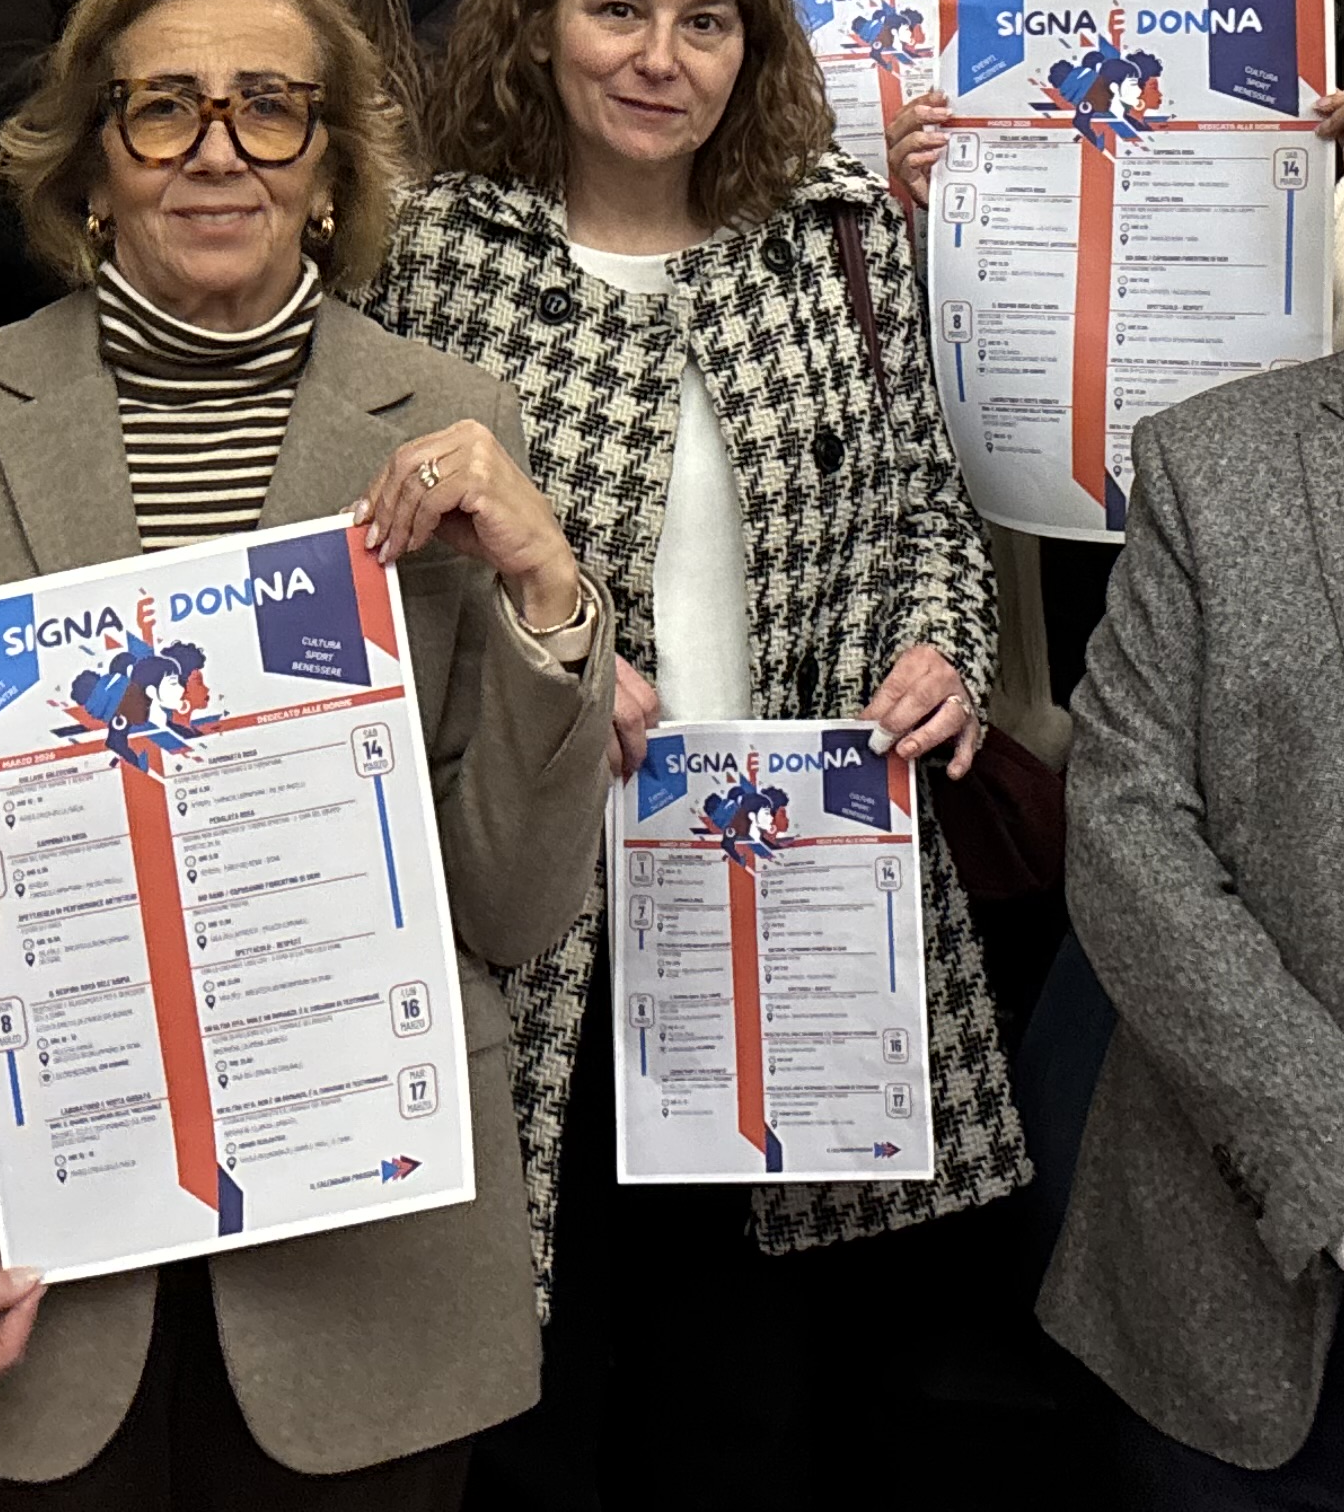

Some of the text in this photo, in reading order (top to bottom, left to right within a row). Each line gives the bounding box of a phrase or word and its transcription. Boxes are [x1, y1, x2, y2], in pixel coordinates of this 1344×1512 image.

[996, 9, 1097, 37] SIGNA
[1136, 7, 1263, 35] DONNA
[1244, 65, 1279, 83] CULTURA
[1246, 77, 1271, 92] SPORT
[960, 144, 967, 159] 1
[1282, 160, 1300, 177] 14
[955, 195, 965, 210] 7
[953, 314, 962, 329] 8
[3, 606, 123, 656] SIGNA
[170, 567, 315, 622] DONNA
[301, 636, 341, 650] CULTURA
[305, 650, 334, 662] SPORT
[292, 662, 343, 677] BENESSERE
[257, 699, 353, 724] DEDICATO ALLE DONNE
[363, 728, 378, 738] SAB
[362, 739, 383, 760] 14
[2, 755, 32, 769] MARZO
[665, 752, 738, 774] SIGNA
[768, 747, 862, 773] DONNA
[639, 862, 645, 875] 1
[882, 867, 895, 881] 14
[638, 906, 645, 919] 7
[400, 998, 421, 1019] 16
[0, 1014, 12, 1033] 8
[890, 1039, 902, 1052] 16
[409, 1080, 427, 1101] 17
[893, 1094, 905, 1107] 17
